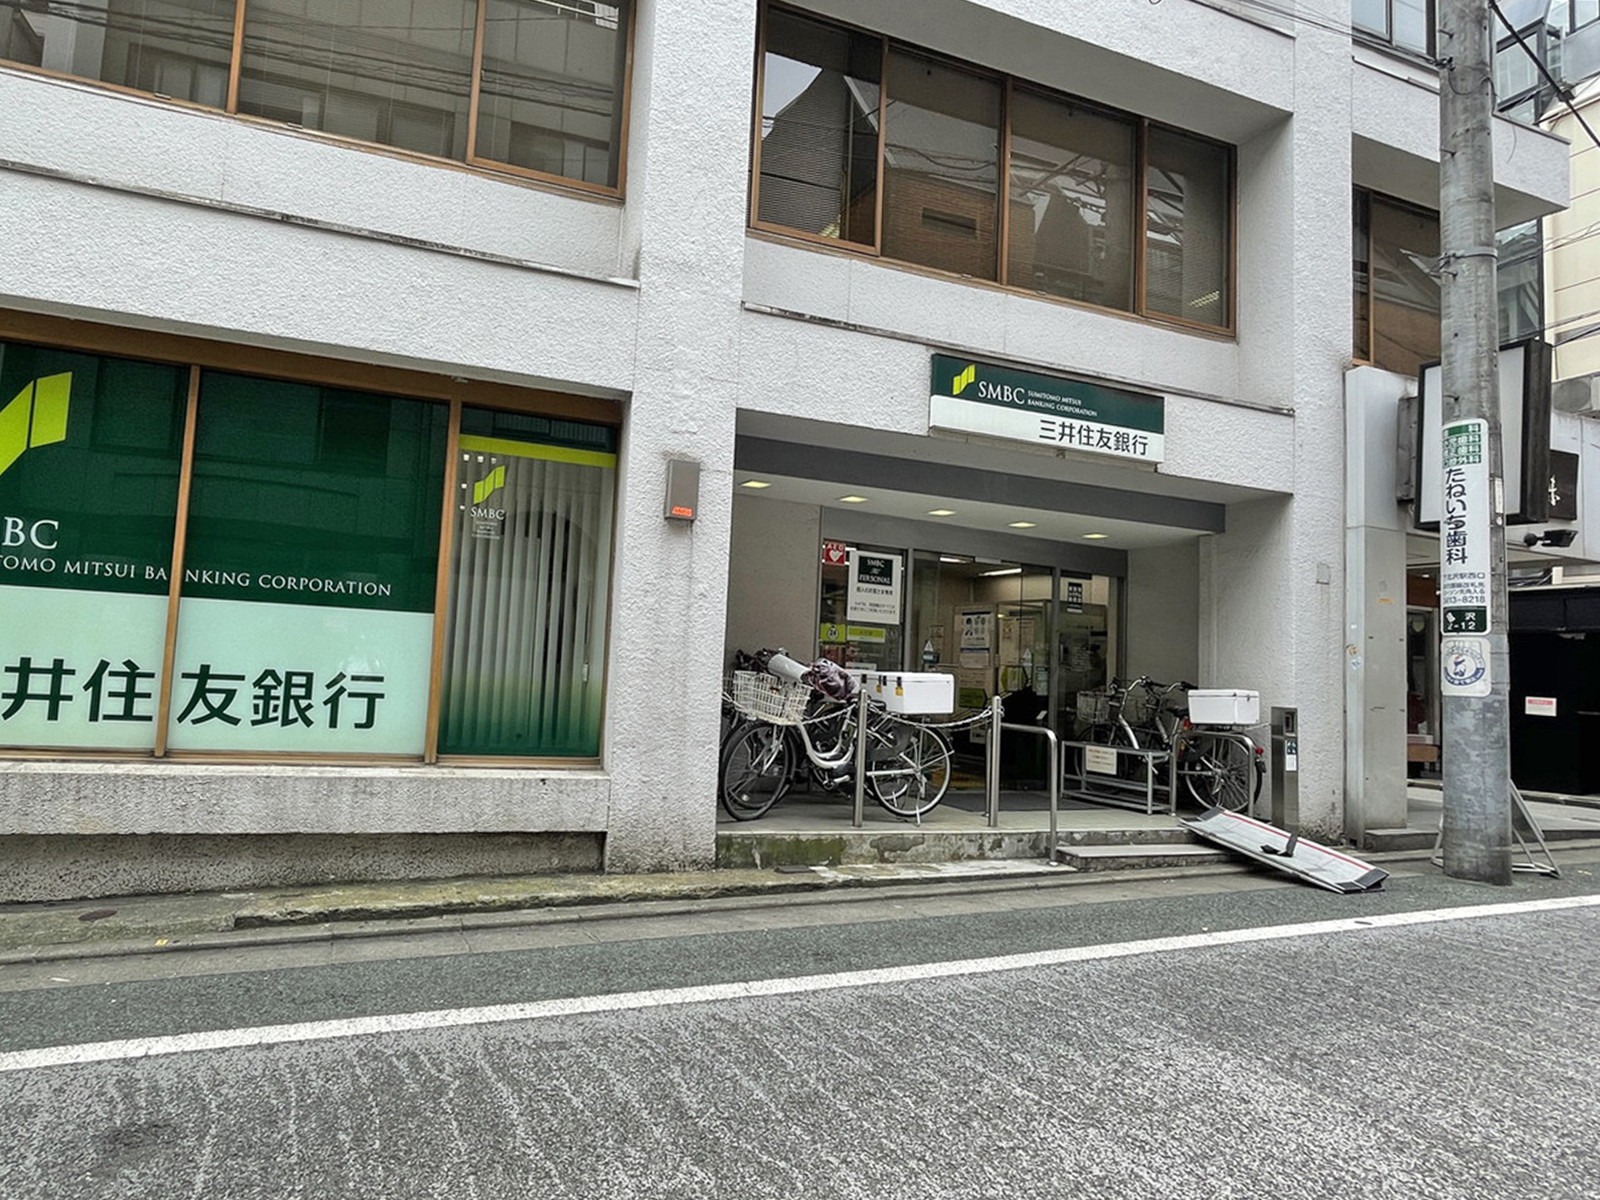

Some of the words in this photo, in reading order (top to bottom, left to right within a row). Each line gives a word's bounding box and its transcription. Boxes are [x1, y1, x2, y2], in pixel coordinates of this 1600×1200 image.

[978, 381, 1025, 405] SMBC
[1027, 390, 1060, 403] SUMITOMO
[1061, 396, 1082, 406] MITSUI
[1027, 399, 1055, 410] BANKING
[1056, 404, 1097, 417] CORPORATION
[1039, 419, 1148, 456] 三井住友銀行
[470, 507, 505, 520] SMBC
[1445, 467, 1467, 565] たねいち歯科
[827, 543, 844, 551] AED
[867, 559, 885, 568] SMBC
[64, 560, 136, 579] MITSUI
[258, 574, 392, 597] CORPORATION
[859, 574, 891, 584] PERSONAL
